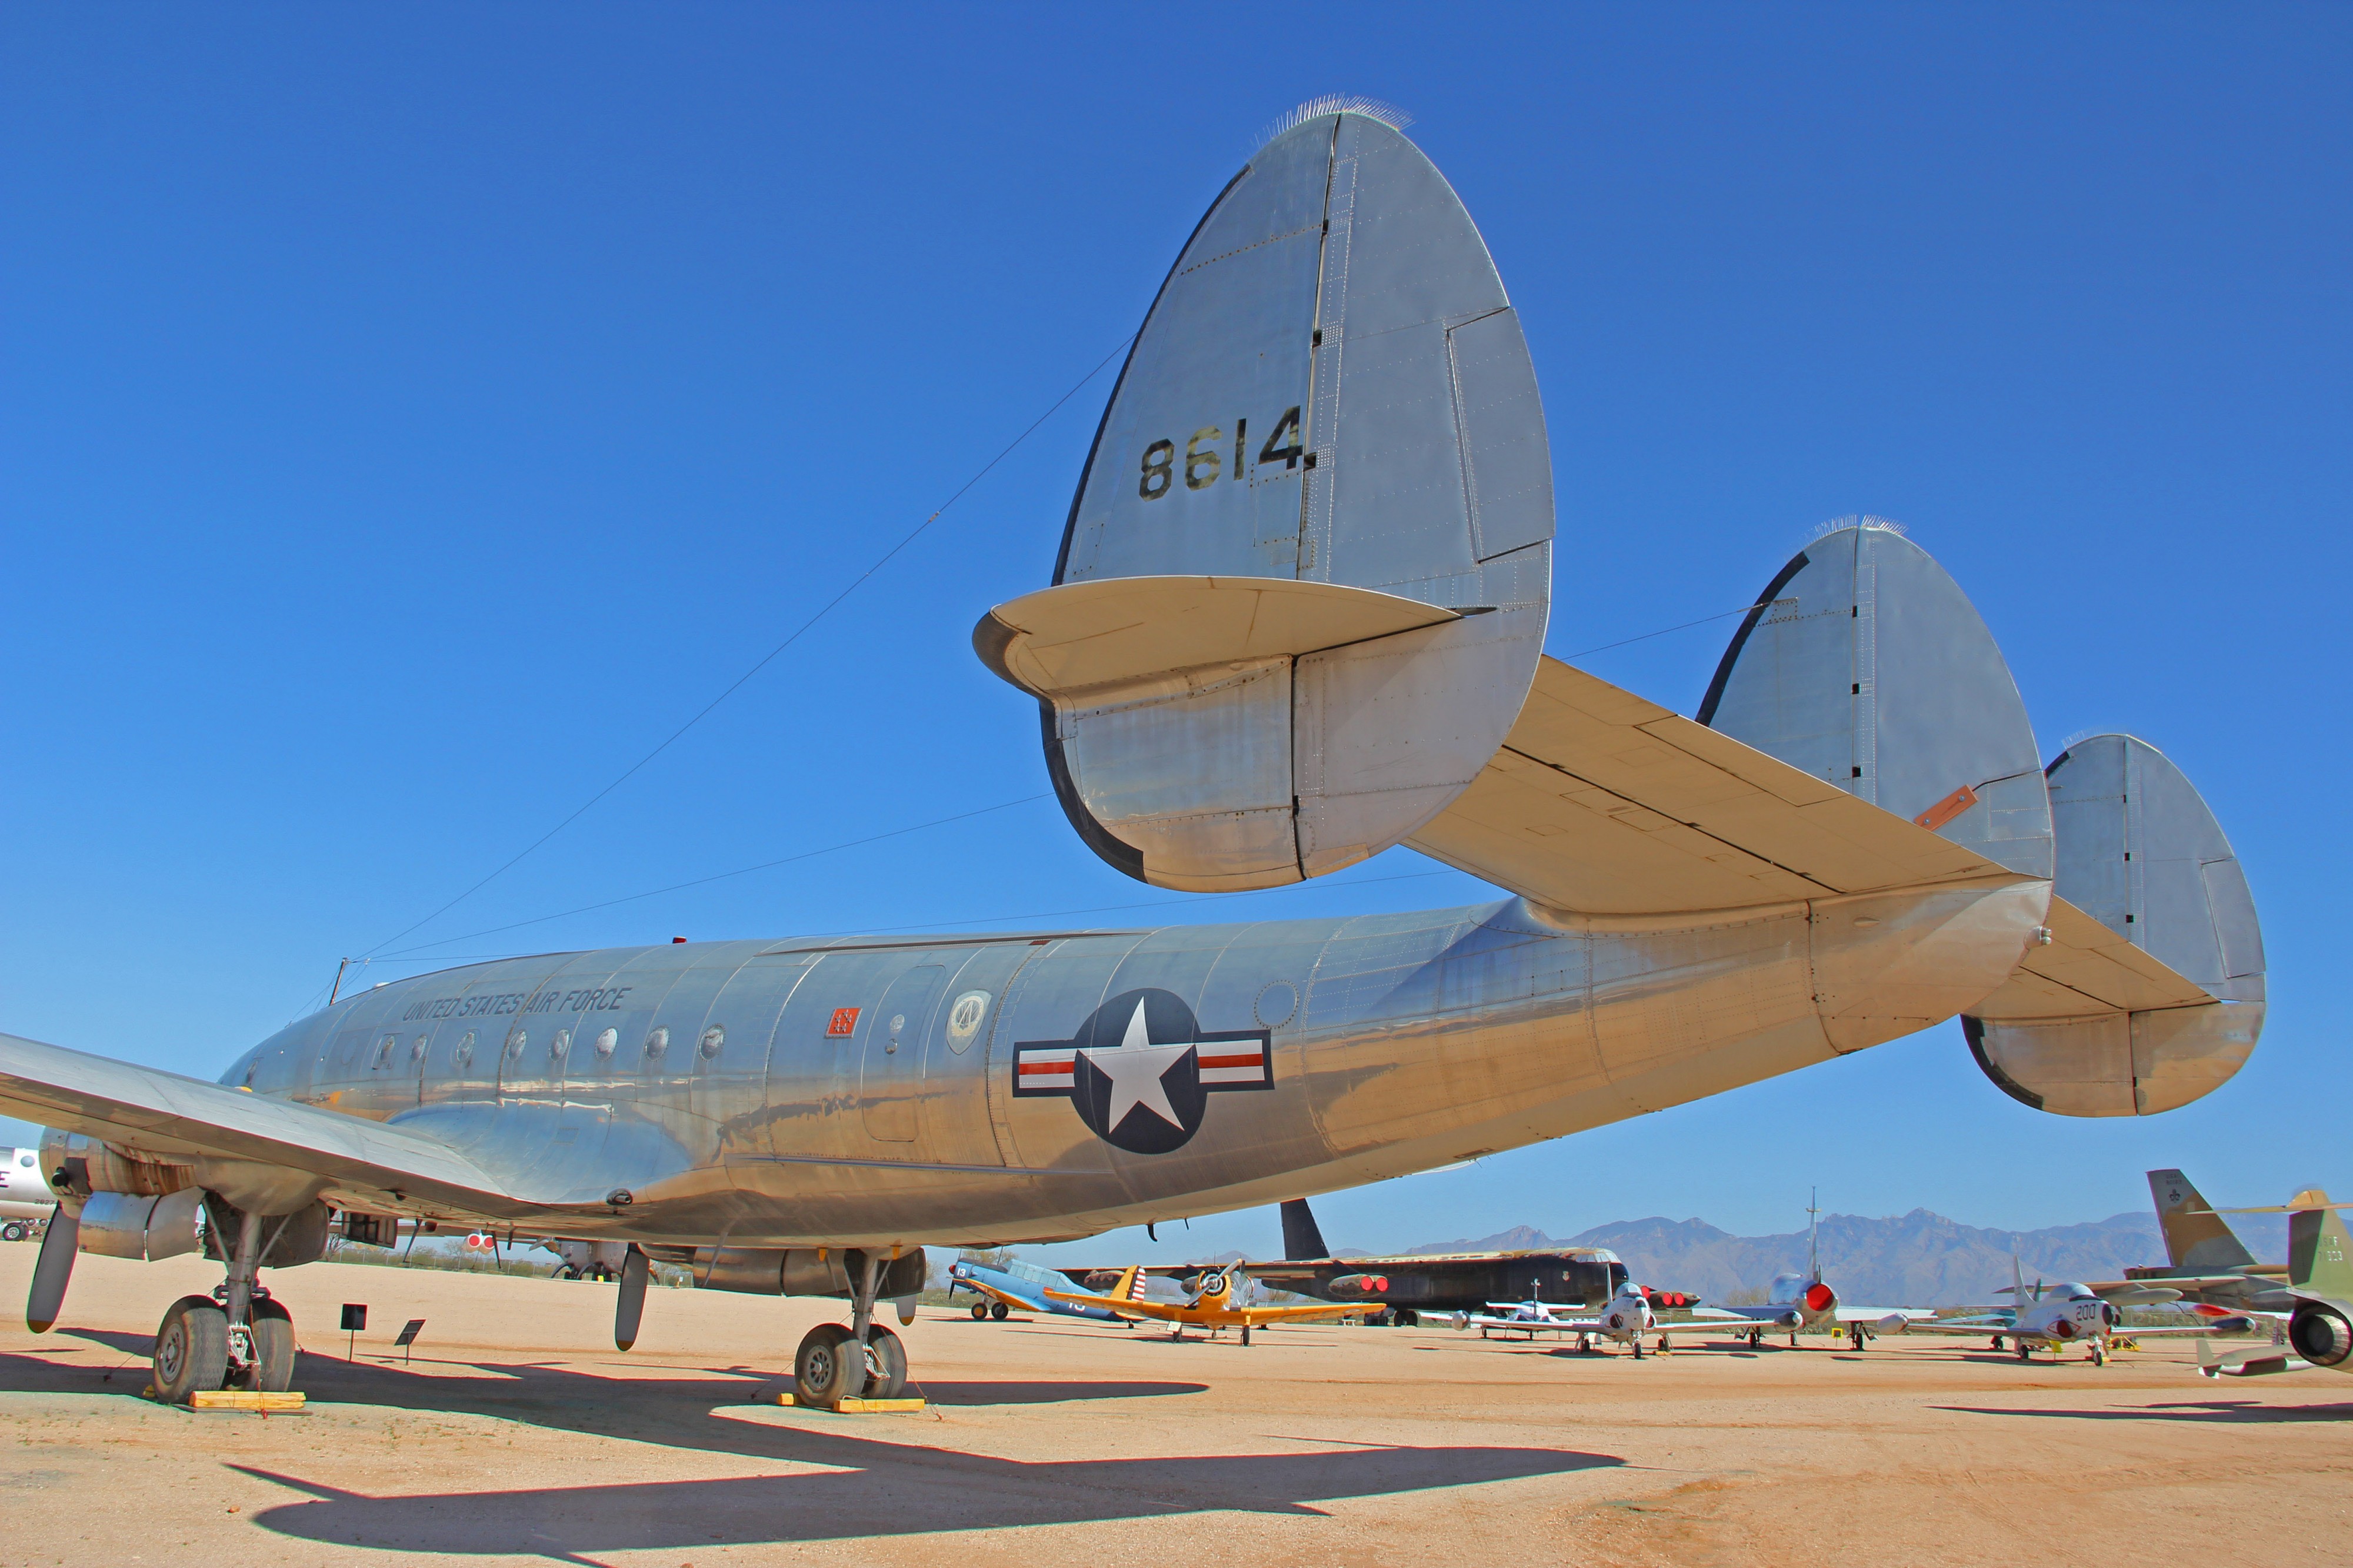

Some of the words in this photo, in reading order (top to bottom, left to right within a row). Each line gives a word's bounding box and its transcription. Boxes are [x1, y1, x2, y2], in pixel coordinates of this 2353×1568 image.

[1139, 405, 1304, 502] 8614
[402, 997, 461, 1021] UNITED
[458, 993, 526, 1017] STATES
[525, 990, 561, 1013] AIR
[558, 987, 633, 1012] FORCE
[957, 1267, 966, 1276] 13
[2076, 1303, 2097, 1321] 200
